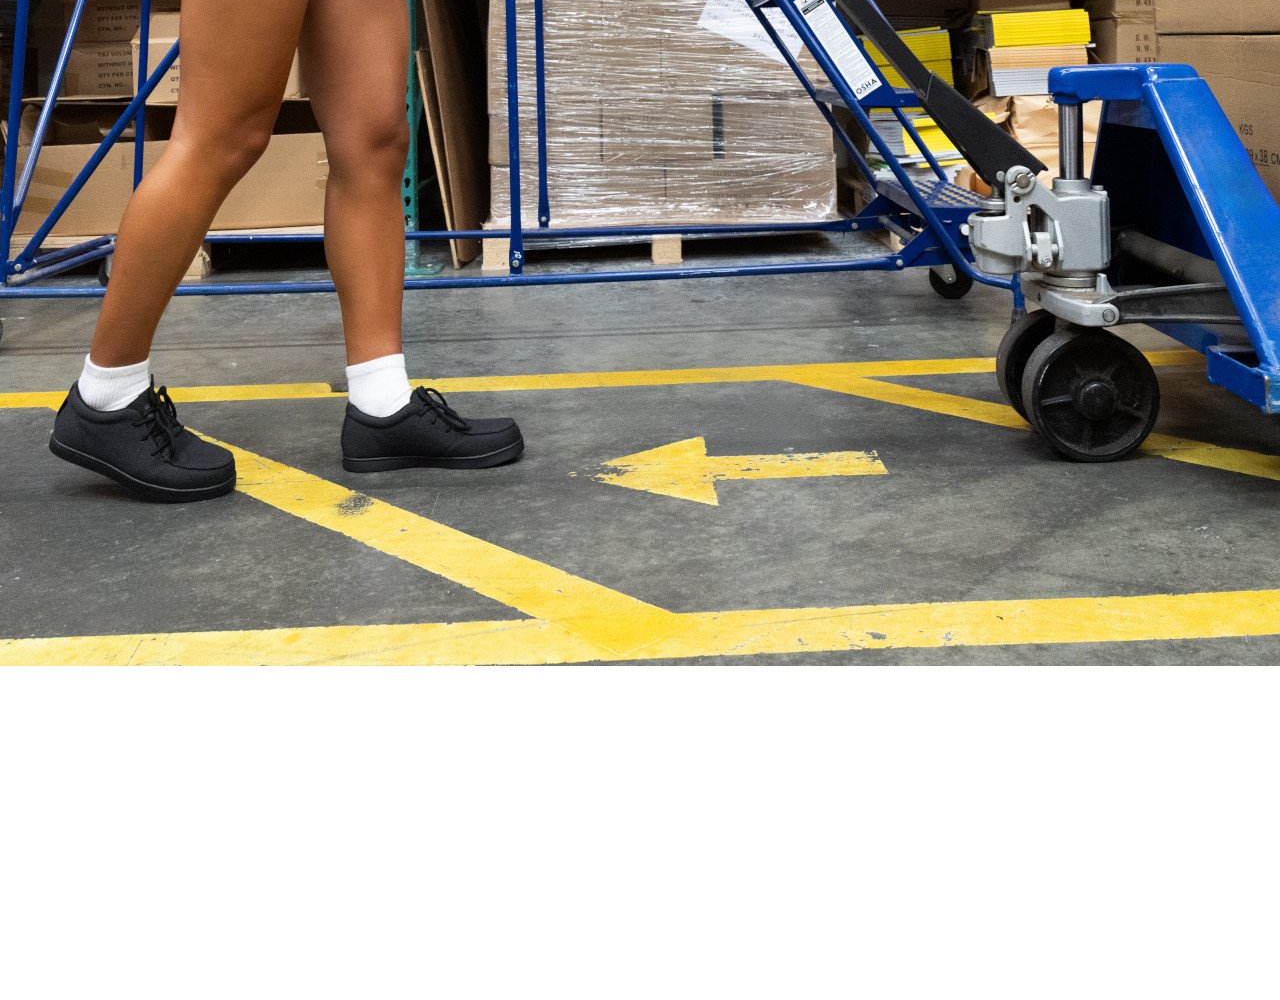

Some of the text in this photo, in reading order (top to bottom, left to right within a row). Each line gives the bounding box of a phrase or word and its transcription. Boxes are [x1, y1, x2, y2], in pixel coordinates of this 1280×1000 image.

[856, 78, 877, 95] OSHA
[1240, 124, 1253, 136] KGS
[1259, 149, 1268, 163] 38
